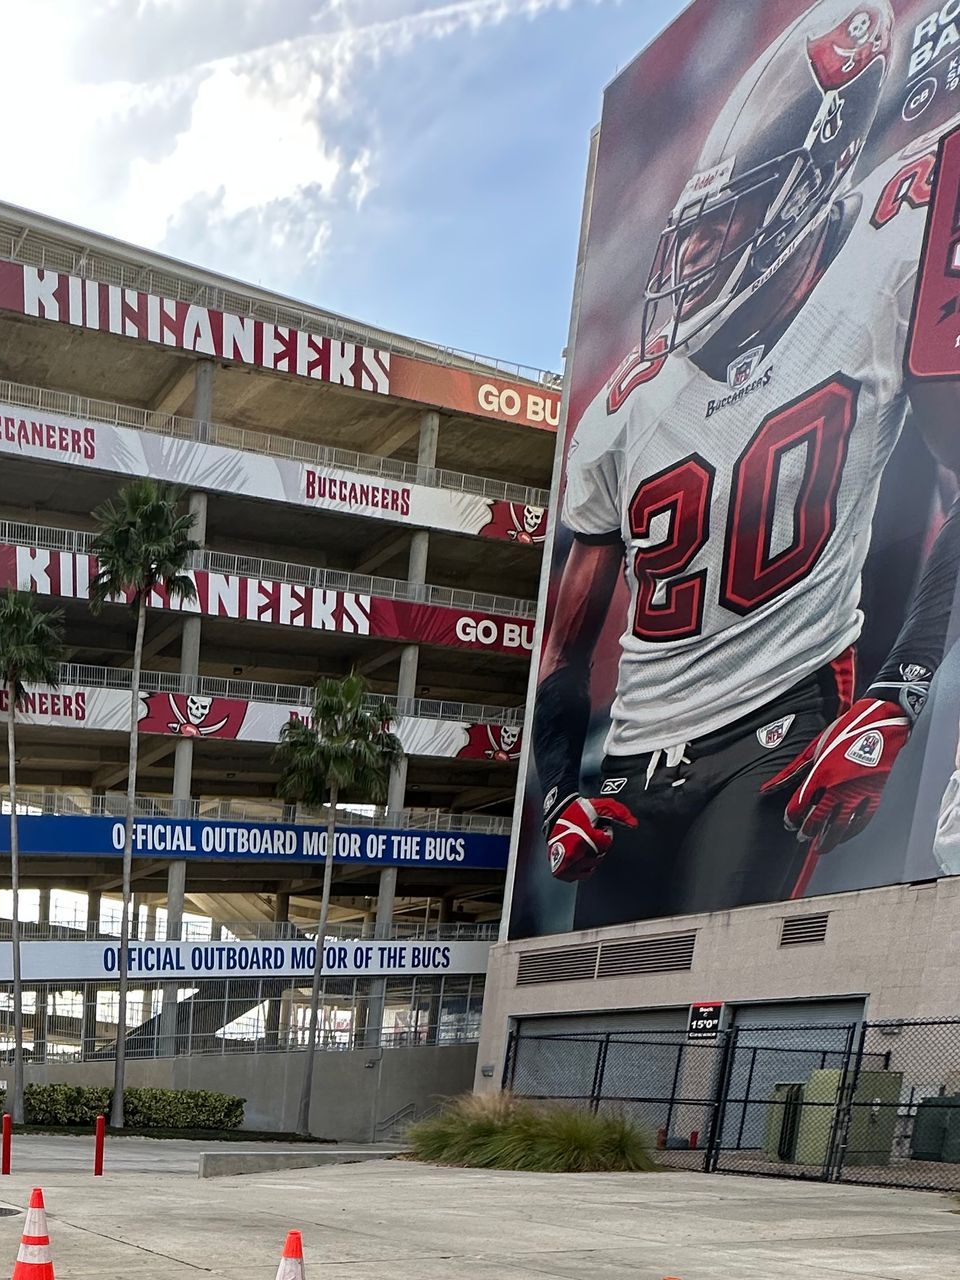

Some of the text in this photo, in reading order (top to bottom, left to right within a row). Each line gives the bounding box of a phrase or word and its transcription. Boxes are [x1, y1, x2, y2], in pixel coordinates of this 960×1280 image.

[910, 89, 929, 109] CB
[478, 384, 521, 416] GO
[305, 470, 410, 516] BUCCANEERS
[628, 371, 861, 643] 20
[456, 617, 498, 645] GO
[201, 827, 297, 855] OUTBOARD
[302, 831, 362, 857] MOTOR
[366, 834, 386, 859] OF
[390, 836, 420, 860] THE
[424, 837, 465, 862] BUCS
[191, 947, 285, 970] OUTBOARD
[291, 946, 348, 969] MOOR
[353, 947, 373, 969] OF
[376, 947, 406, 969] THE
[411, 946, 450, 969] BUCS
[691, 1020, 719, 1030] 15'0"
